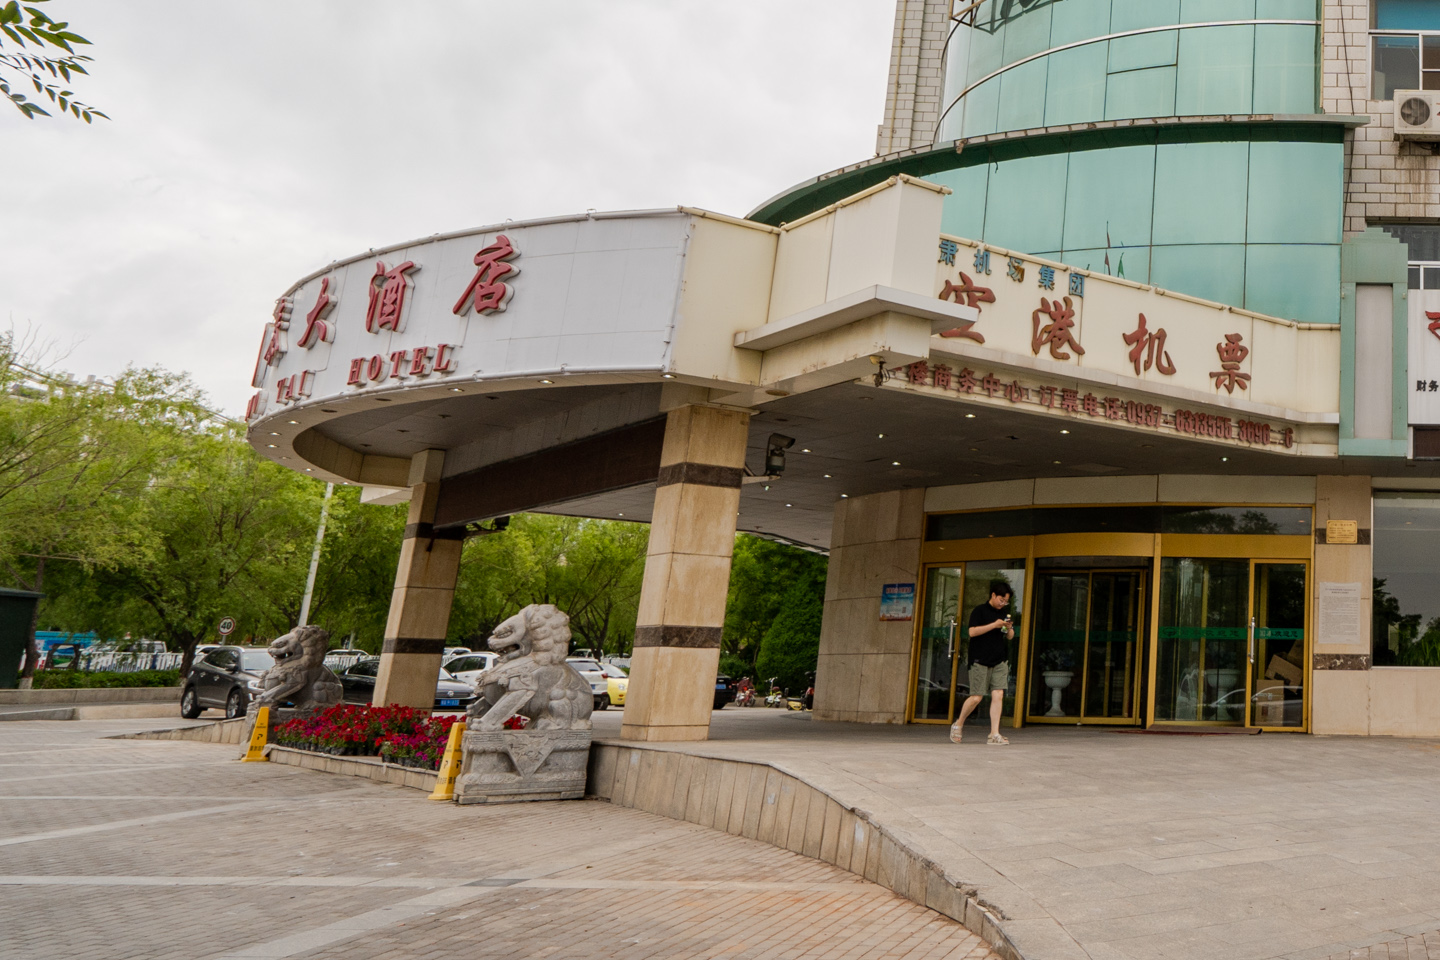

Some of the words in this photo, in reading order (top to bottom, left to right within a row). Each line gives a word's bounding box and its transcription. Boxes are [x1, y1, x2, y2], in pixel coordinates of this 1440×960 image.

[939, 271, 1252, 394] 空港机票
[347, 344, 456, 385] HOTEL
[893, 360, 1024, 404] 楼商务中心
[220, 621, 232, 630] 40
